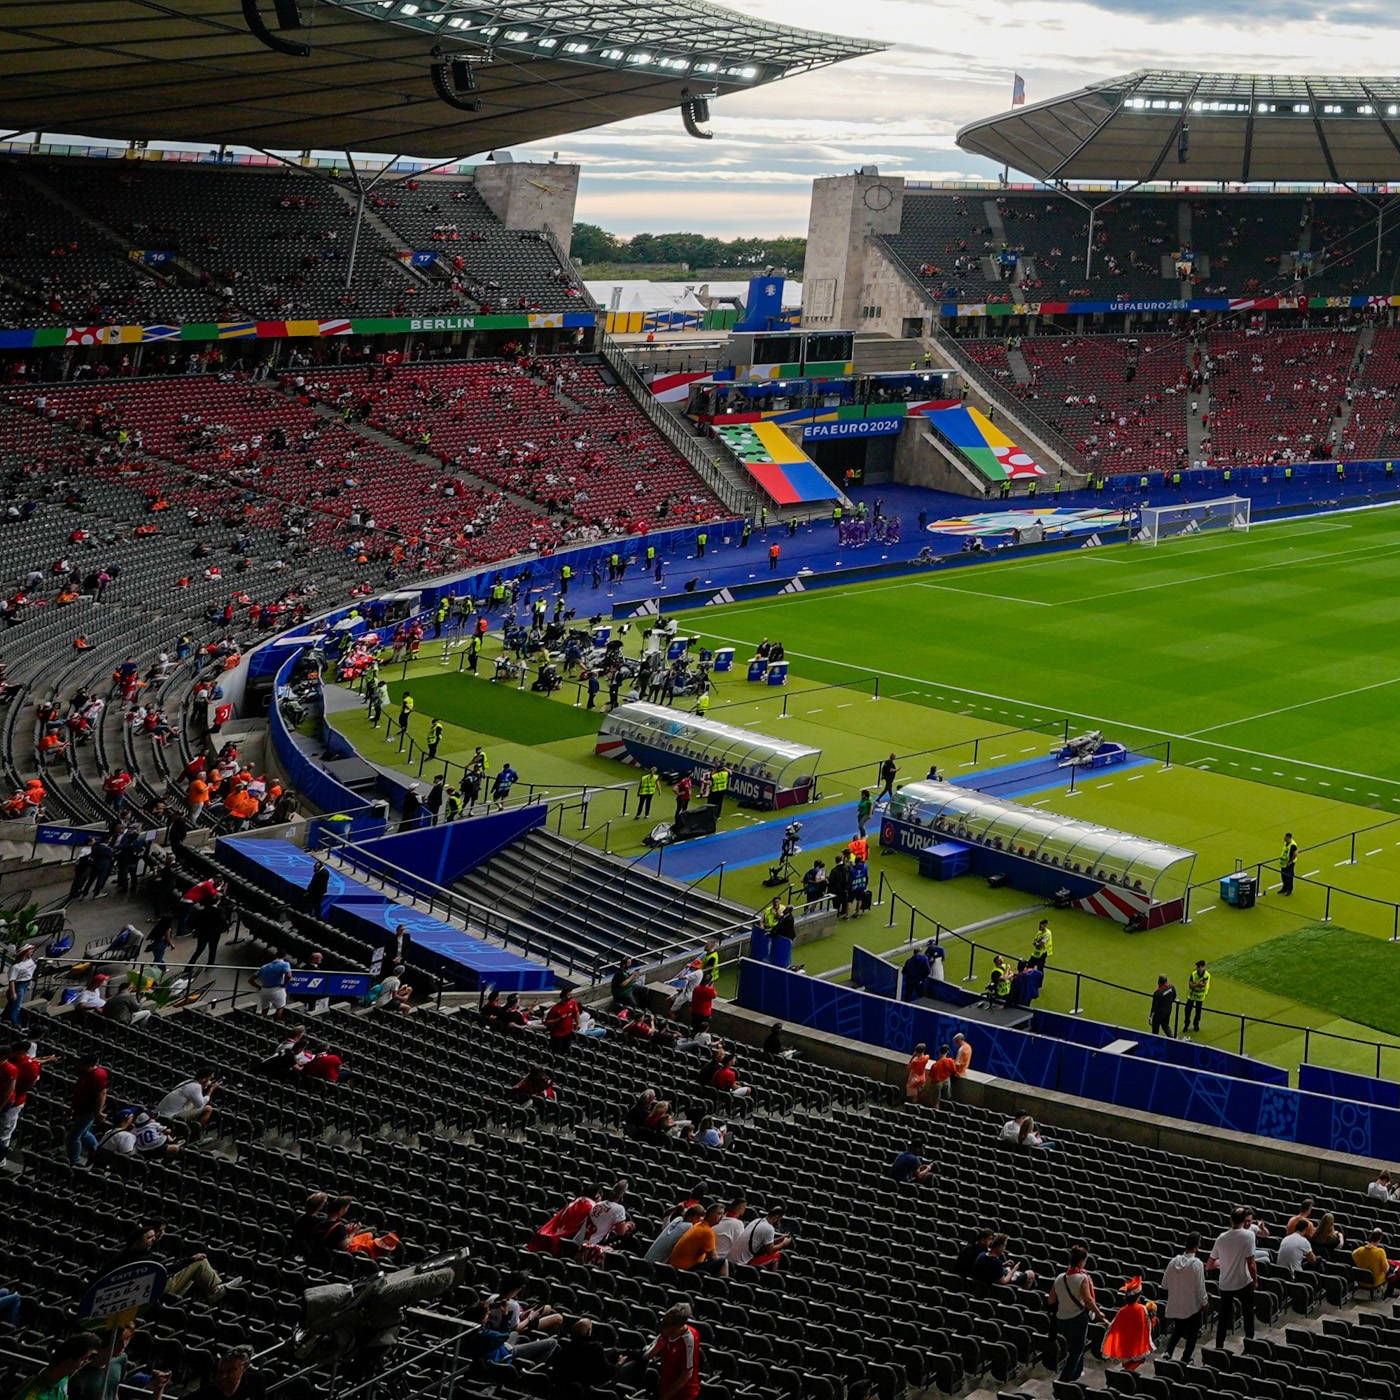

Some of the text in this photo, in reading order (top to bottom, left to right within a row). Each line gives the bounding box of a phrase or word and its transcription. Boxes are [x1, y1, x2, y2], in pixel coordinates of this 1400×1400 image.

[152, 252, 167, 262] 16
[418, 253, 431, 263] 17
[410, 317, 476, 331] BERLIN
[139, 1131, 153, 1145] 10
